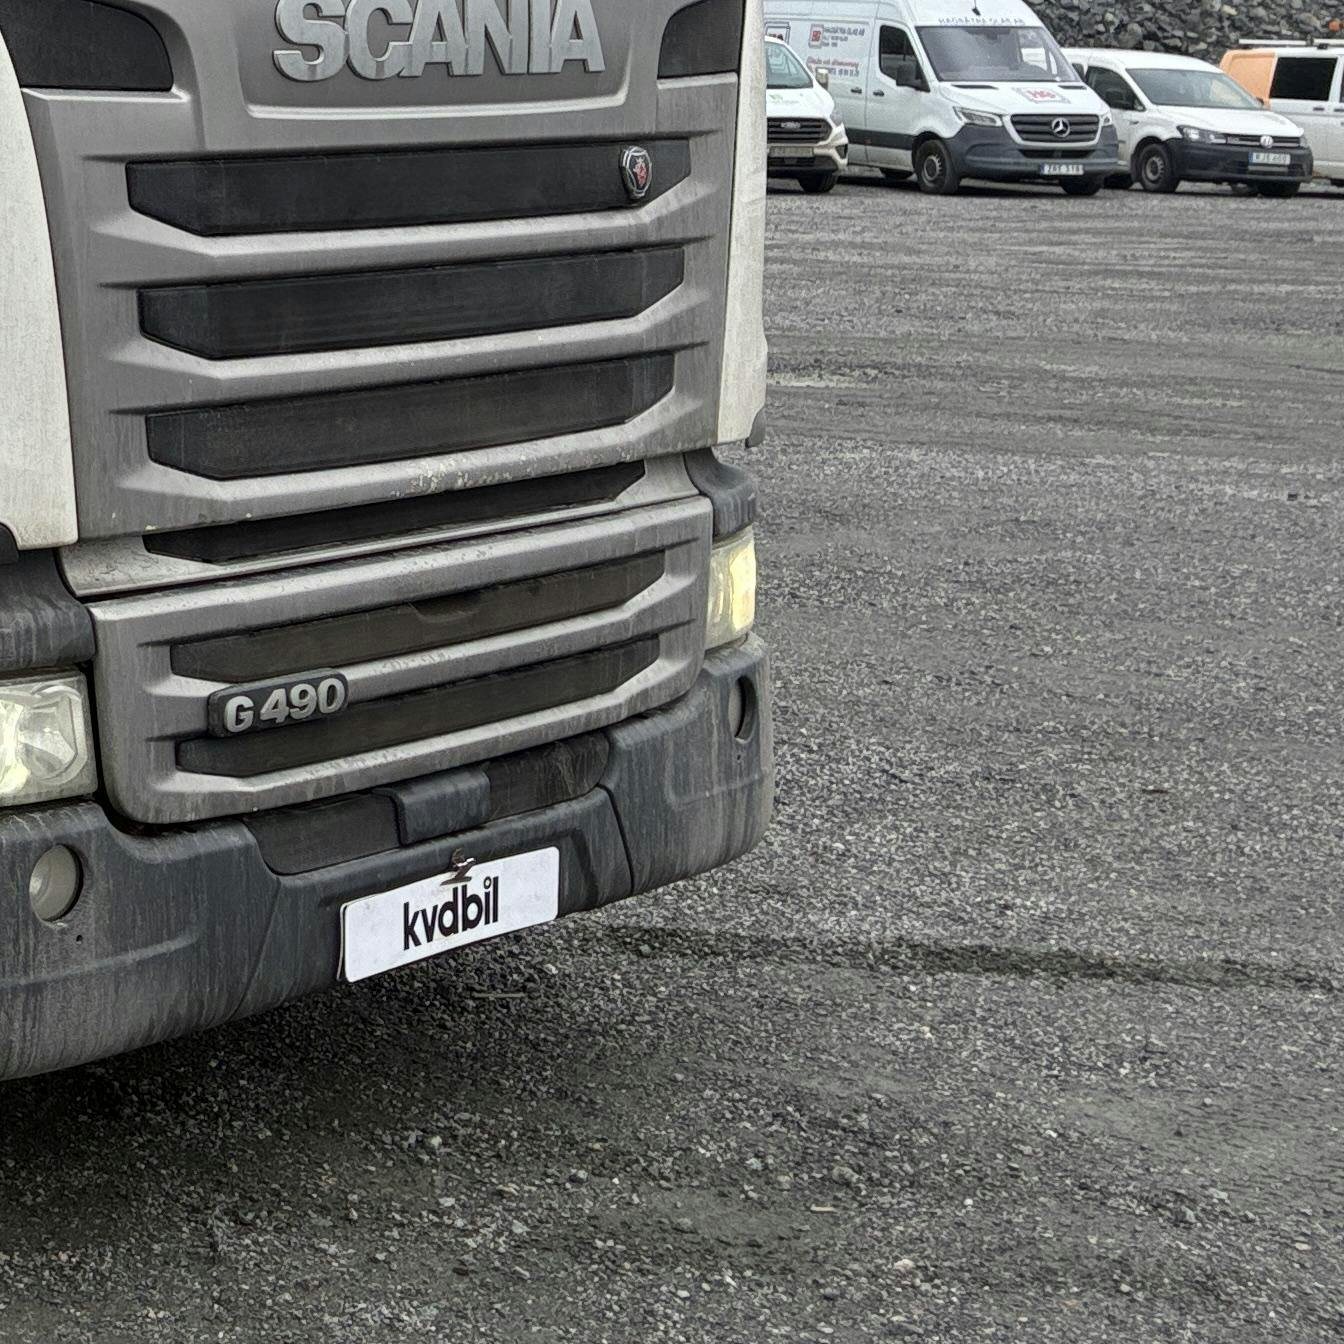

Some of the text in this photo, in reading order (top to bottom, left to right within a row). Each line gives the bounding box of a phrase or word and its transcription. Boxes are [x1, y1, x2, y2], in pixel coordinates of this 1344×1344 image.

[224, 677, 346, 733] G 490
[403, 876, 499, 951] kvdbil
